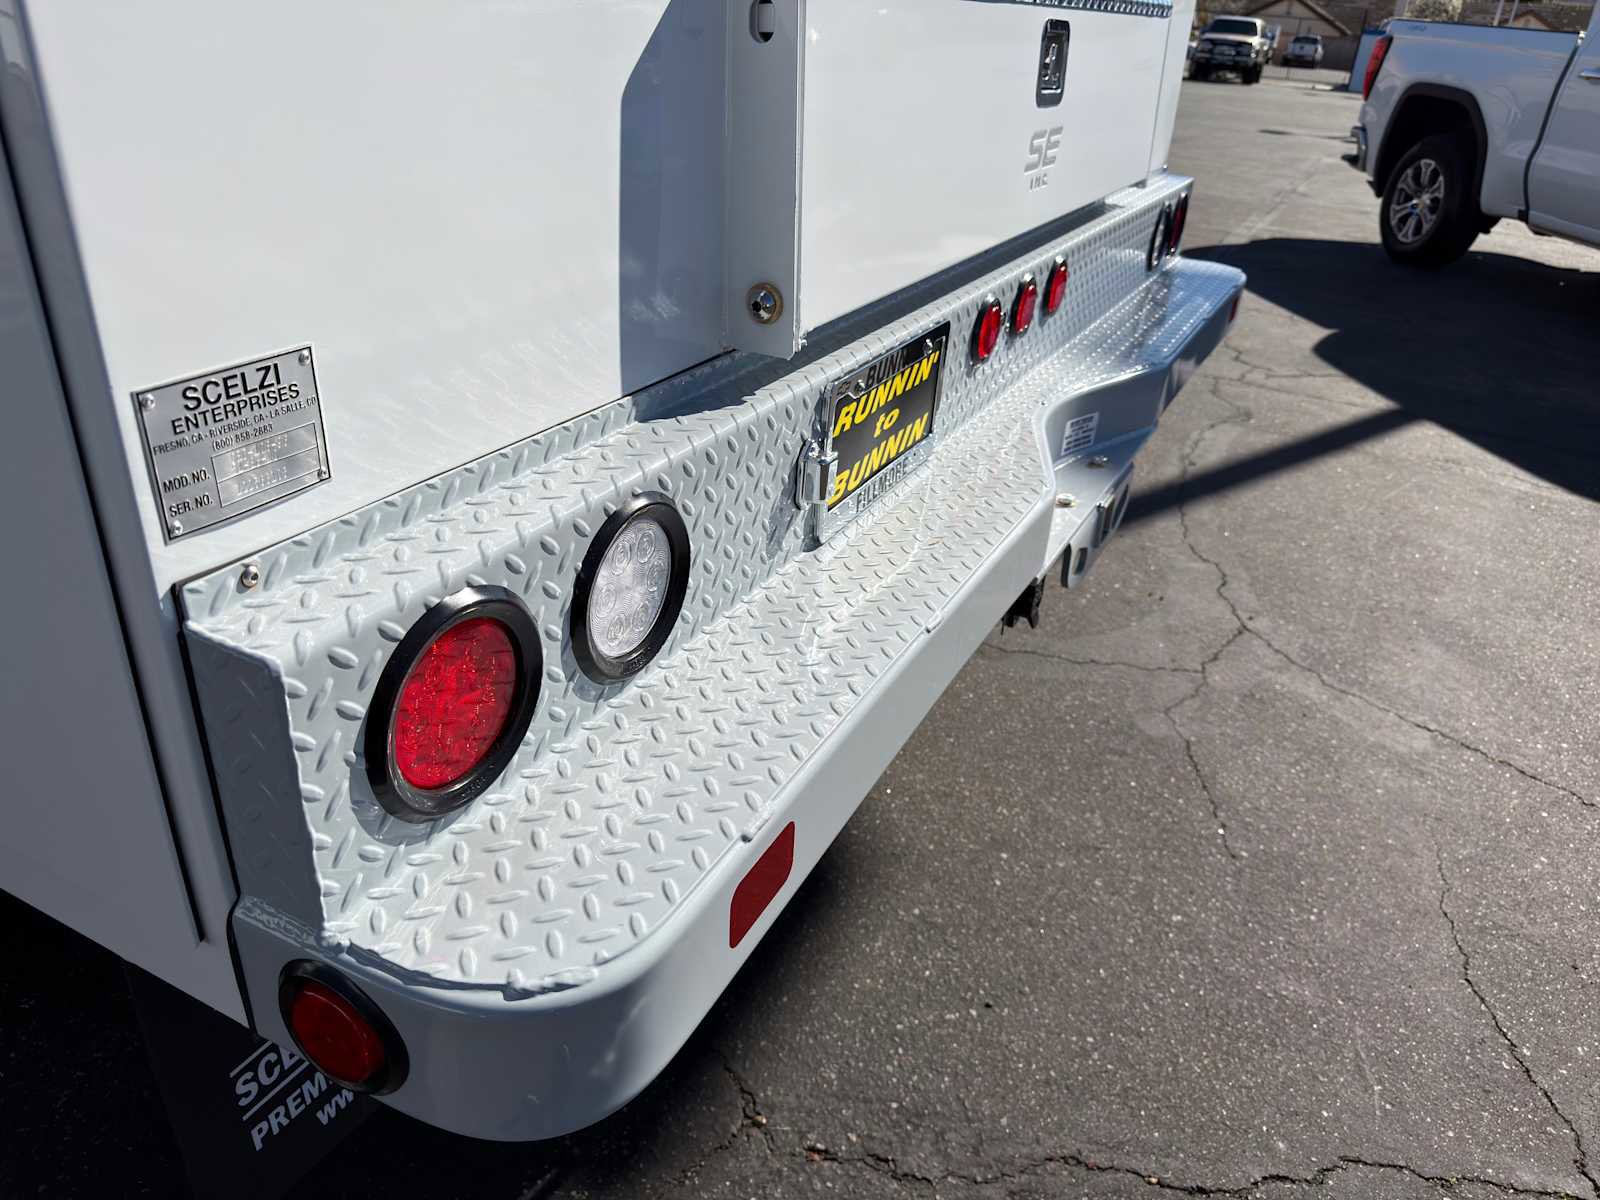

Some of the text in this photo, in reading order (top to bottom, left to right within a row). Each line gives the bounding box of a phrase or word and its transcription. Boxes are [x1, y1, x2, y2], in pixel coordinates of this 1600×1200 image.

[1024, 126, 1064, 172] SE
[170, 383, 300, 436] ENTERPRISES
[181, 362, 281, 412] SCELZI
[832, 350, 940, 438] RUNNIN'
[153, 436, 191, 456] FRESNO,
[209, 416, 253, 439] RIVERSIDE,
[212, 436, 234, 452] (800)
[874, 408, 900, 439] to
[163, 468, 210, 494] MOD. NO.
[826, 412, 929, 506] BUNNIN
[169, 494, 213, 518] SER. NO.
[251, 1070, 332, 1152] PREM
